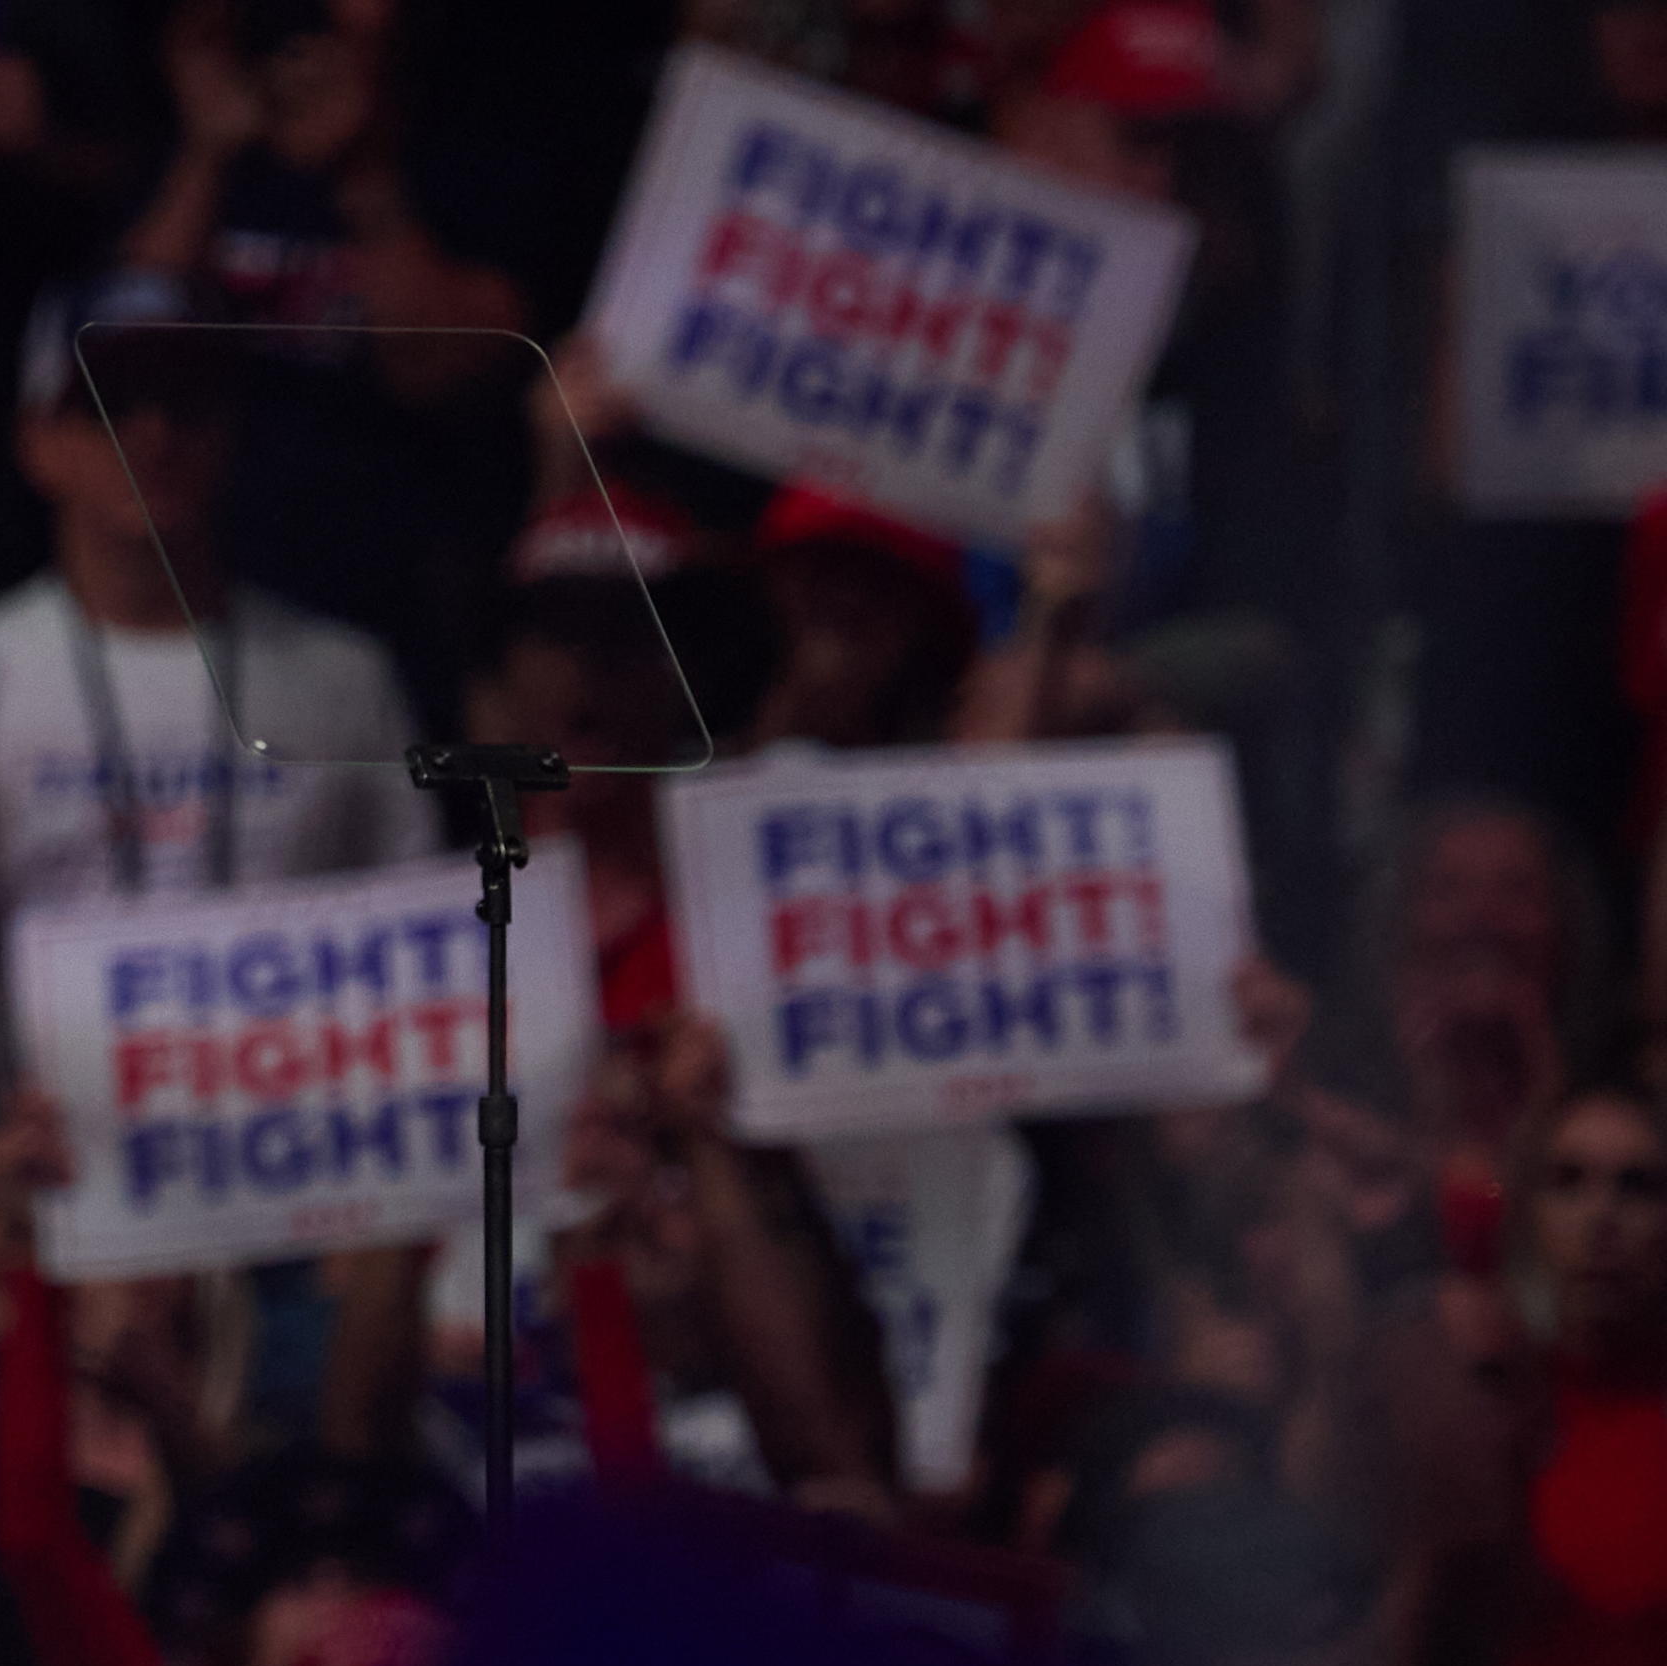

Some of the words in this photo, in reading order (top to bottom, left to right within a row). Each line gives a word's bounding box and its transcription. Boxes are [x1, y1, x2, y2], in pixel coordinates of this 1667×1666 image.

[727, 118, 1107, 322] FIGHT!
[695, 208, 1073, 402] FIGHT!
[670, 295, 1039, 500] FIGHT!
[757, 787, 1157, 886] FIGHT!
[770, 862, 1167, 976] FIGHT!
[782, 958, 1179, 1080] FIGHT!
[124, 1086, 513, 1212] FIGHT
